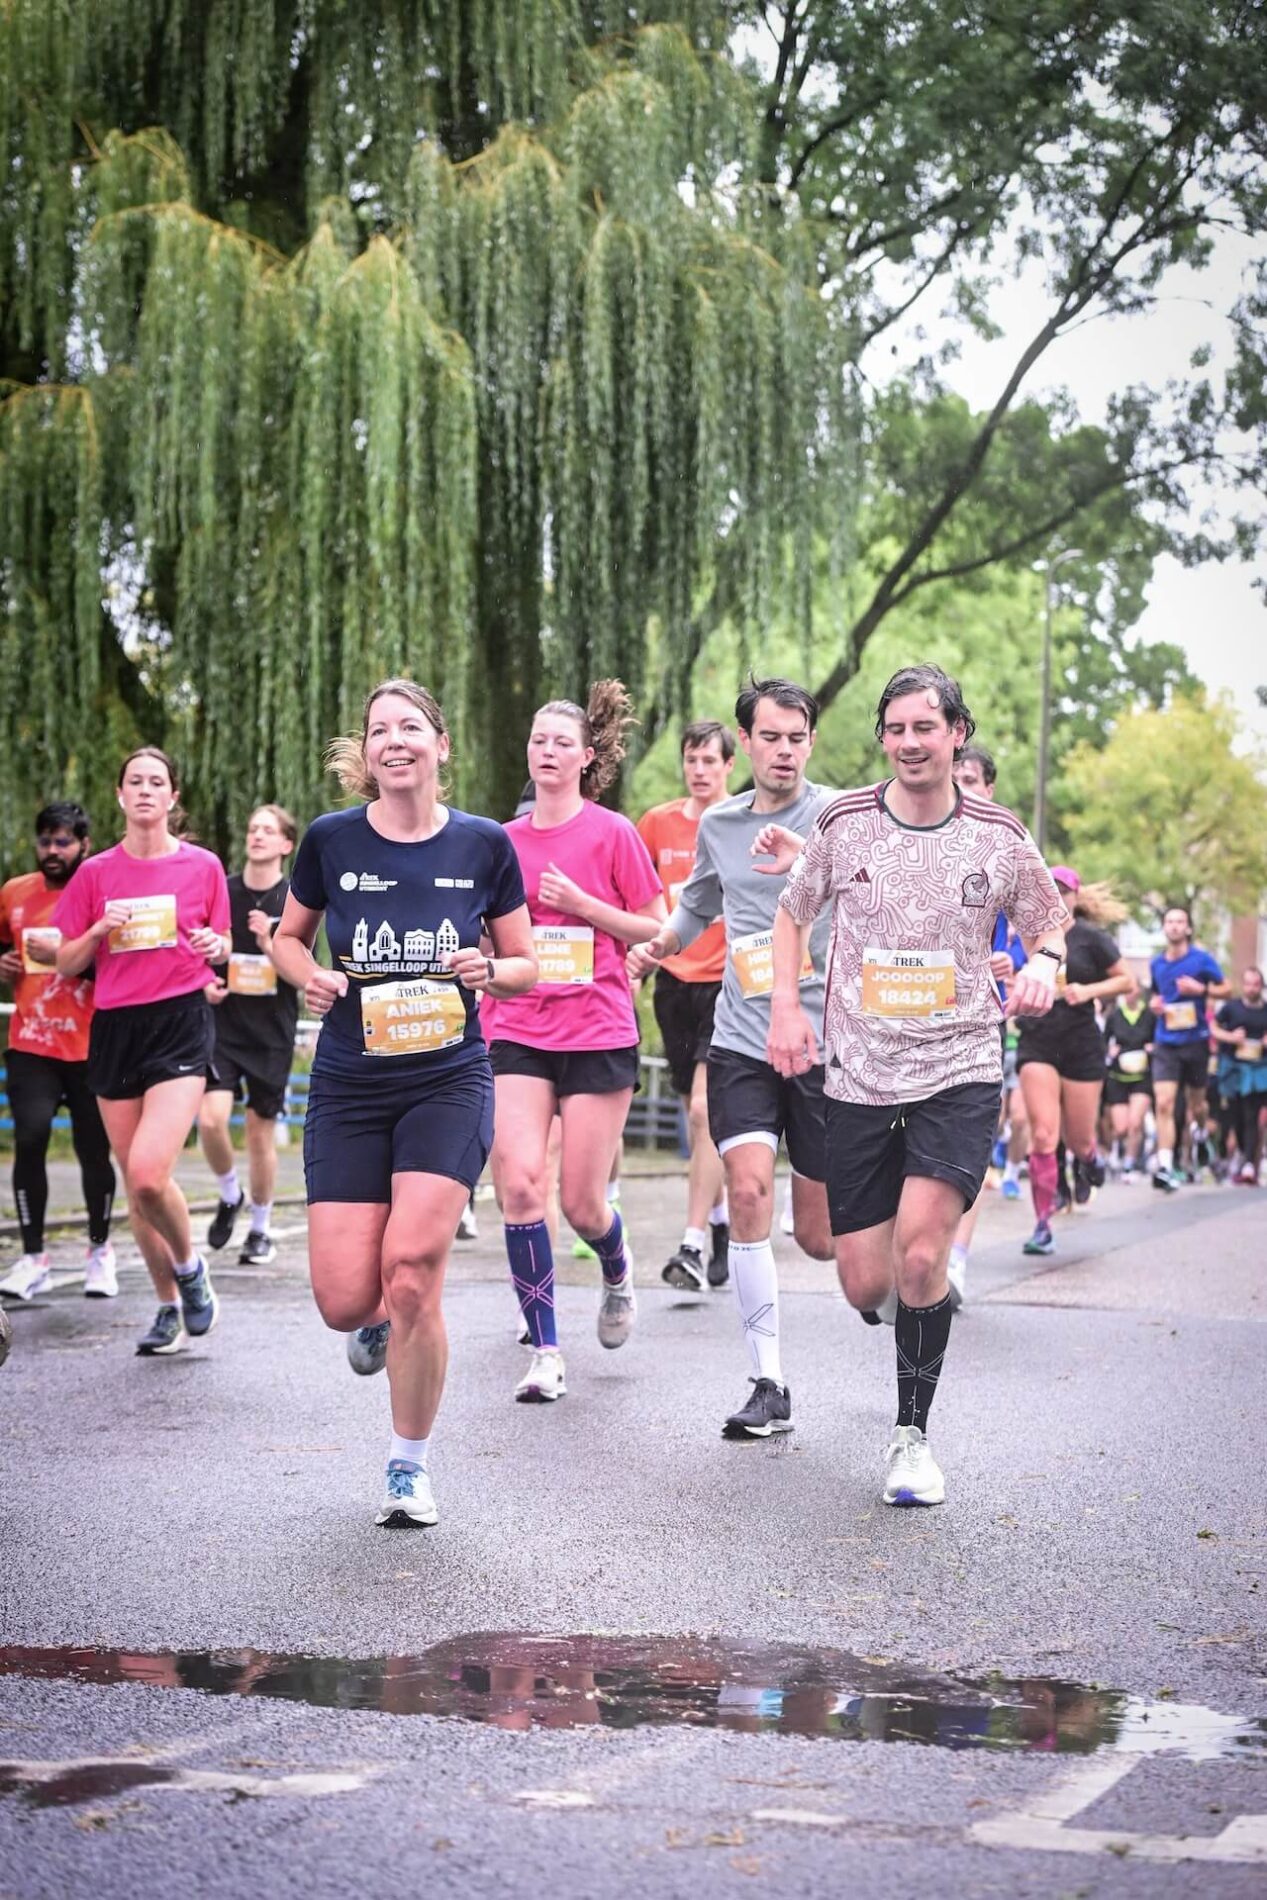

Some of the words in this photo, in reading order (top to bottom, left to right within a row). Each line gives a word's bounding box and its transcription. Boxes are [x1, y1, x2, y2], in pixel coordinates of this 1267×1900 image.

[543, 931, 567, 940] TREK
[364, 961, 427, 973] SINGELLOOP
[538, 958, 576, 972] 1789
[892, 956, 925, 967] TREK
[871, 970, 945, 983] JOOOOOP
[395, 984, 429, 998] TREK
[878, 989, 937, 1005] 18424
[386, 999, 444, 1019] ANIEK
[387, 1019, 446, 1041] 15976
